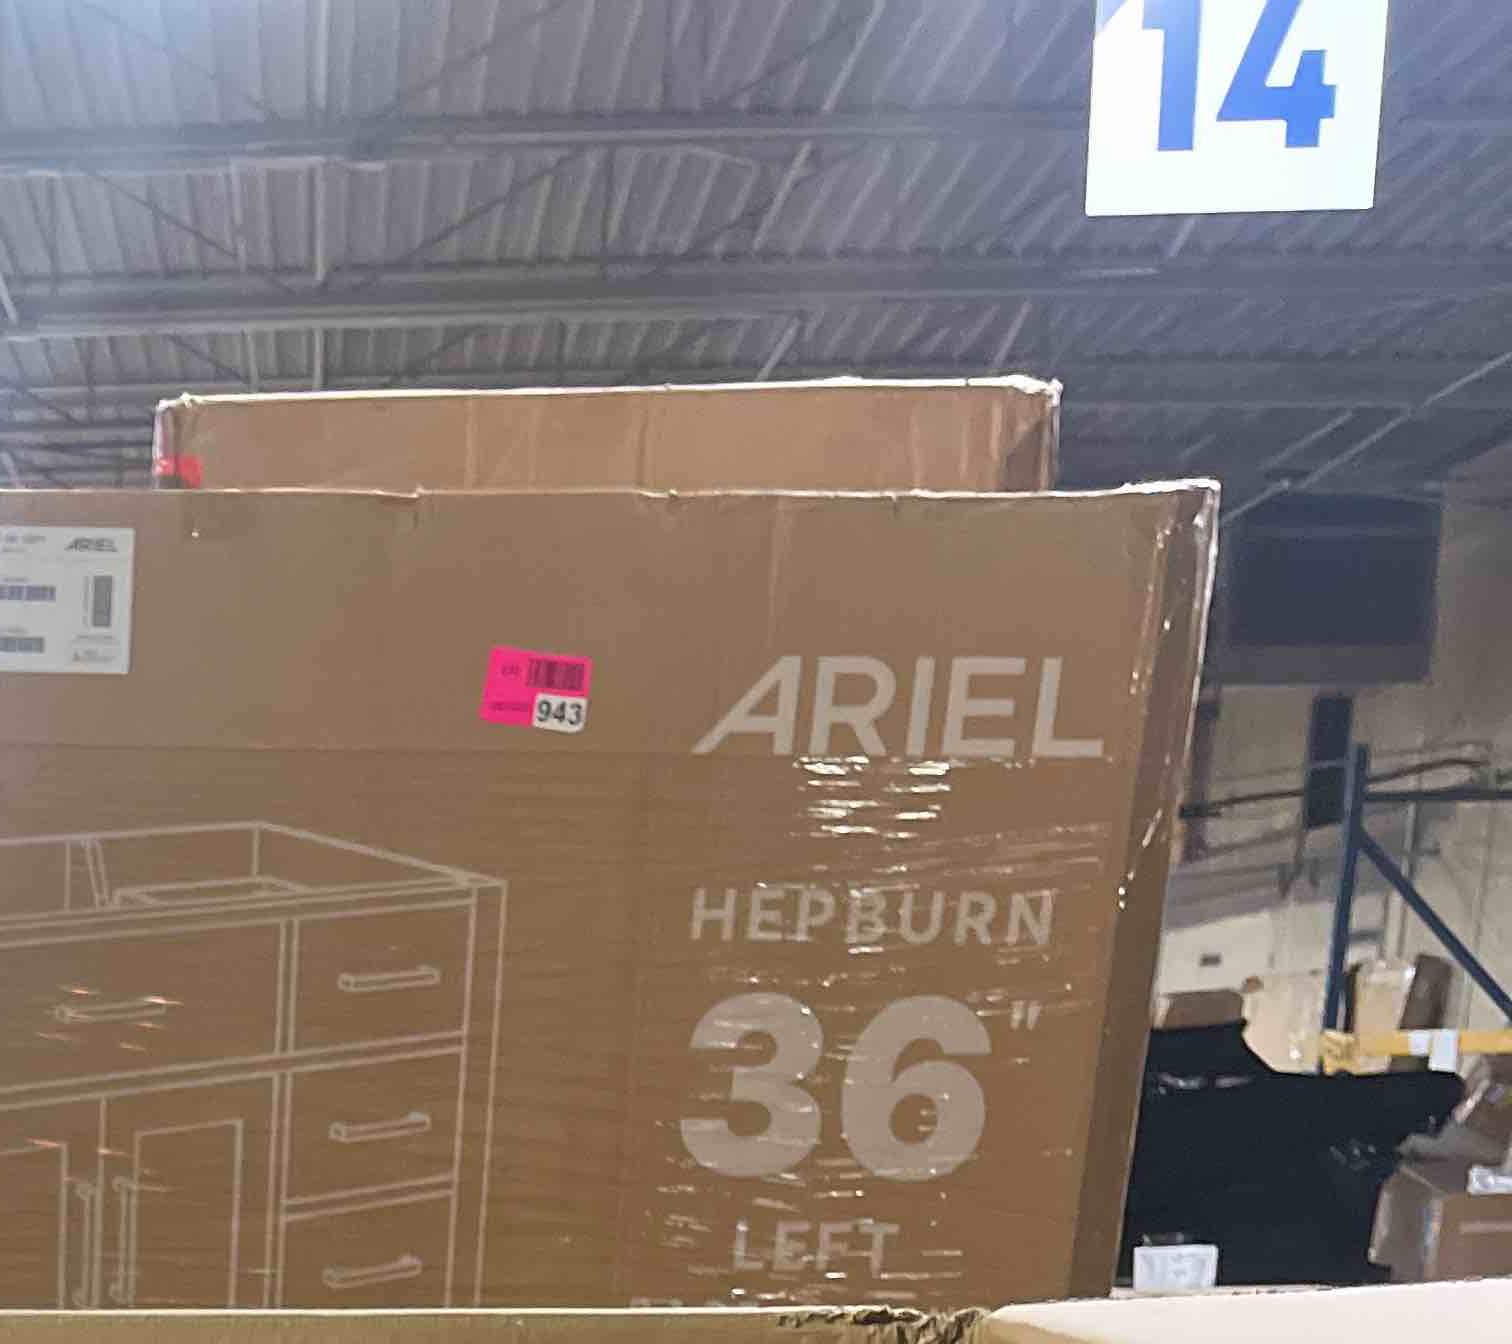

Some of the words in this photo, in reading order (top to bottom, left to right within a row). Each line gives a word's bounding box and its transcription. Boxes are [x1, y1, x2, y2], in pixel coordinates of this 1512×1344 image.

[1142, 0, 1337, 151] 14
[536, 699, 583, 726] 943
[691, 655, 1104, 758] ARIEL
[689, 885, 1056, 946] HEPBURN
[680, 991, 1041, 1183] 36"
[732, 1219, 900, 1279] LEFT
